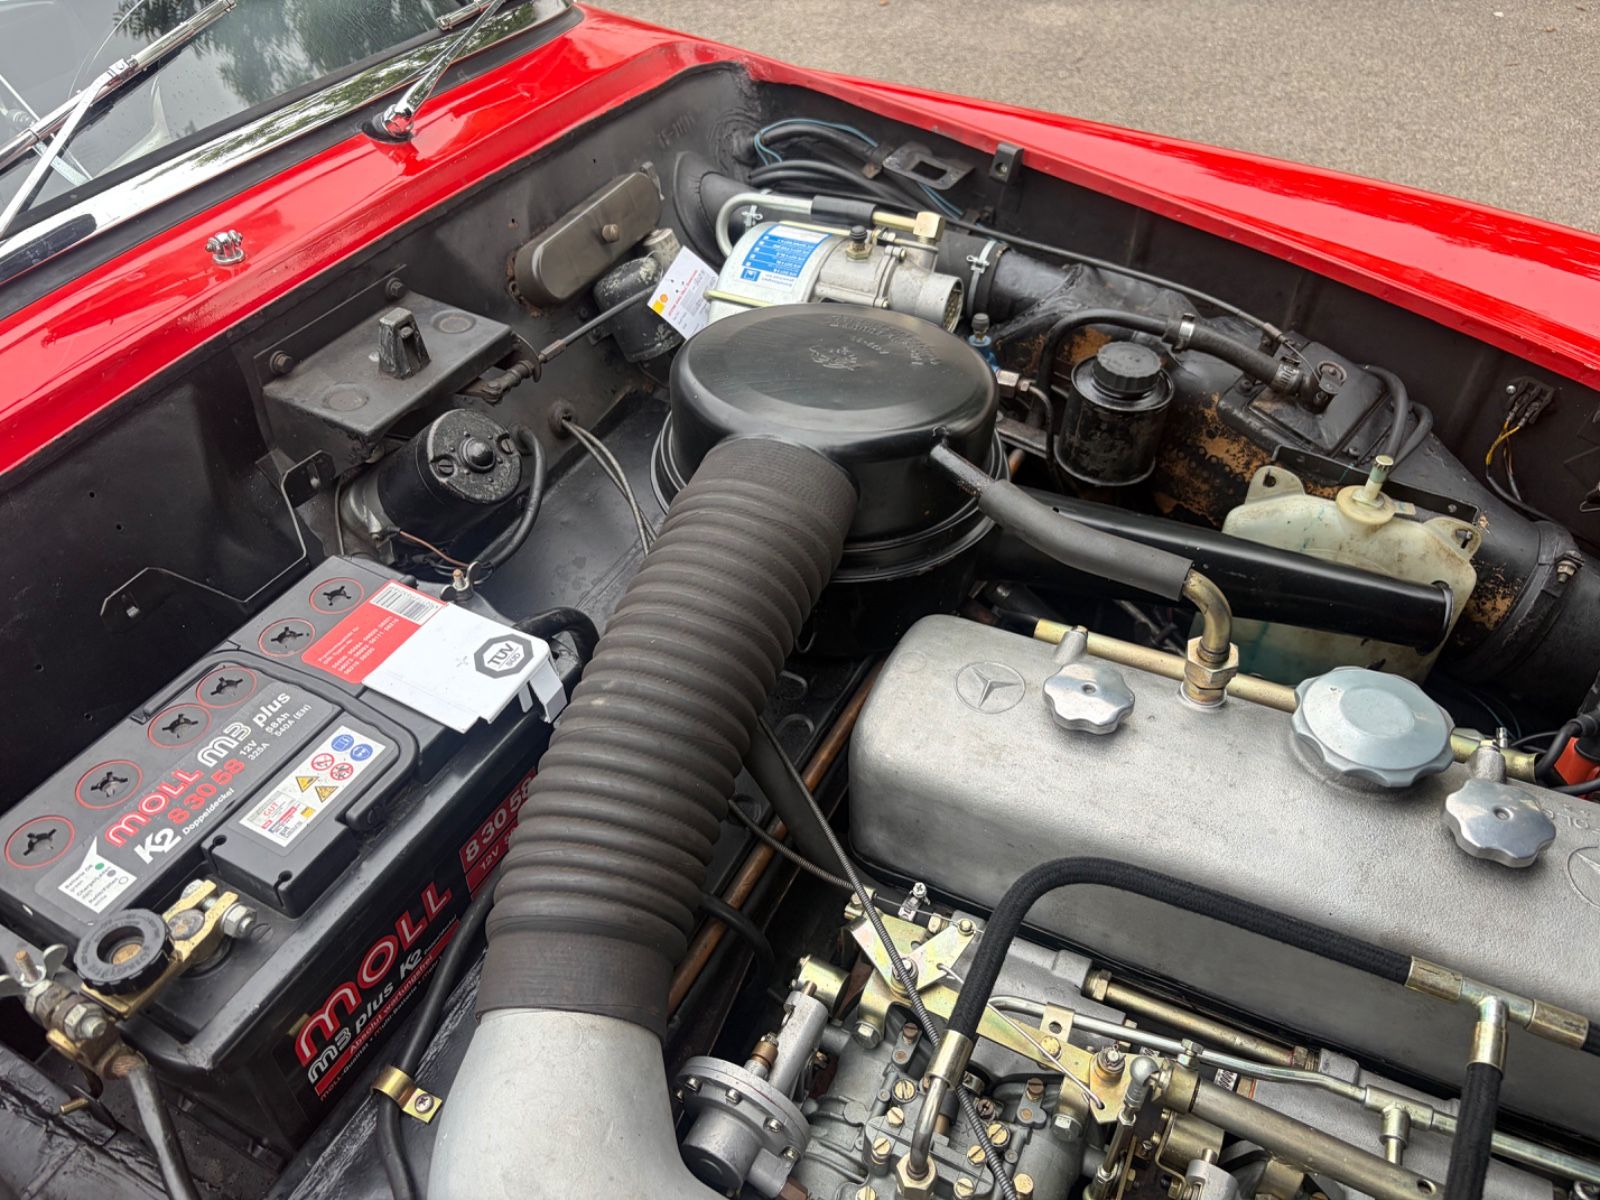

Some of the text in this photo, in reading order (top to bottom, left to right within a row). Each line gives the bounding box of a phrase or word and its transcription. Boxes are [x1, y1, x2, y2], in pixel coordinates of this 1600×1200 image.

[248, 742, 269, 761] 325A
[274, 719, 295, 737] 540A
[254, 692, 291, 728] plus
[167, 712, 291, 825] 8 30 58 12V 58Ah
[134, 828, 182, 864] K2
[182, 788, 235, 836] Doppeldeckel
[465, 838, 479, 861] 8
[483, 811, 507, 841] 30
[349, 954, 434, 1055] Absolut wartungsfrei
[356, 981, 393, 1033] plus
[399, 948, 423, 980] K2
